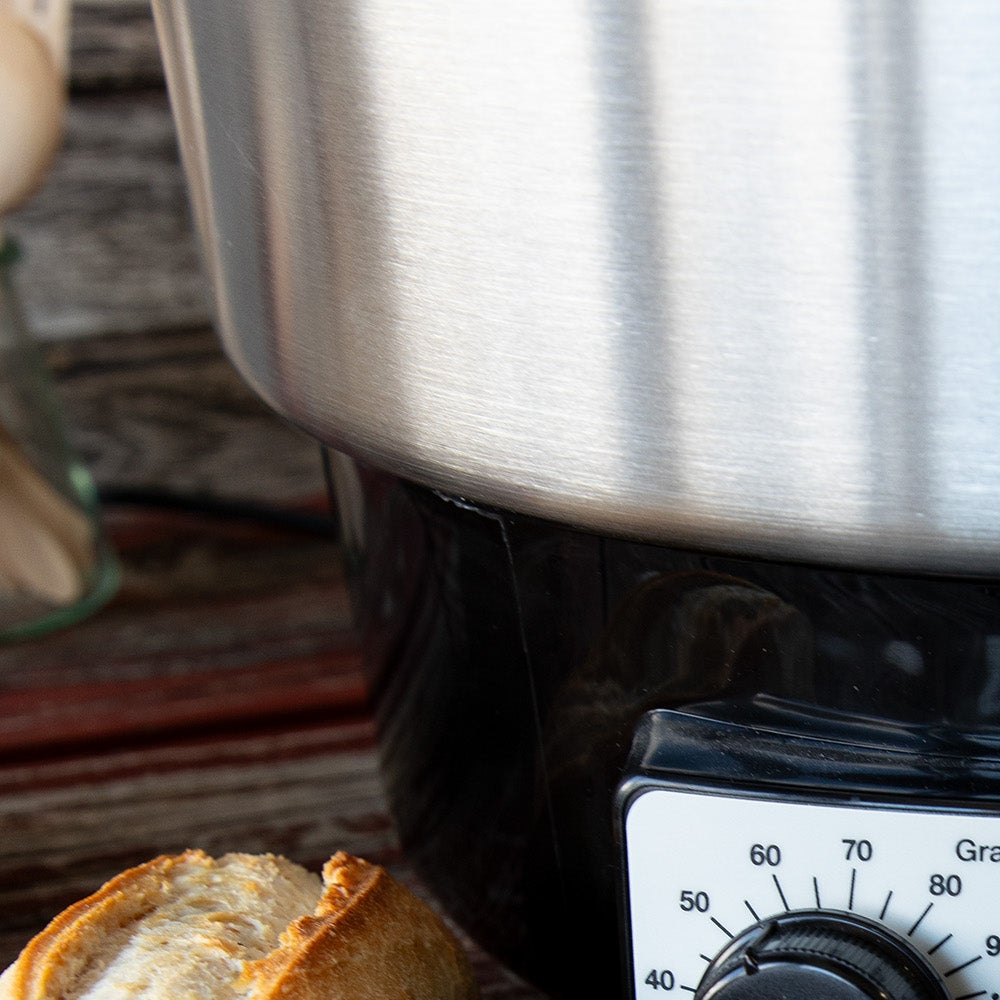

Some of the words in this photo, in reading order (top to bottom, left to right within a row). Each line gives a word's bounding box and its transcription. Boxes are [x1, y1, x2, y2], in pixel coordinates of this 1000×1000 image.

[750, 843, 781, 867] 60
[842, 839, 873, 862] 70
[929, 873, 962, 897] 80
[680, 890, 710, 913] 50
[644, 969, 675, 991] 40
